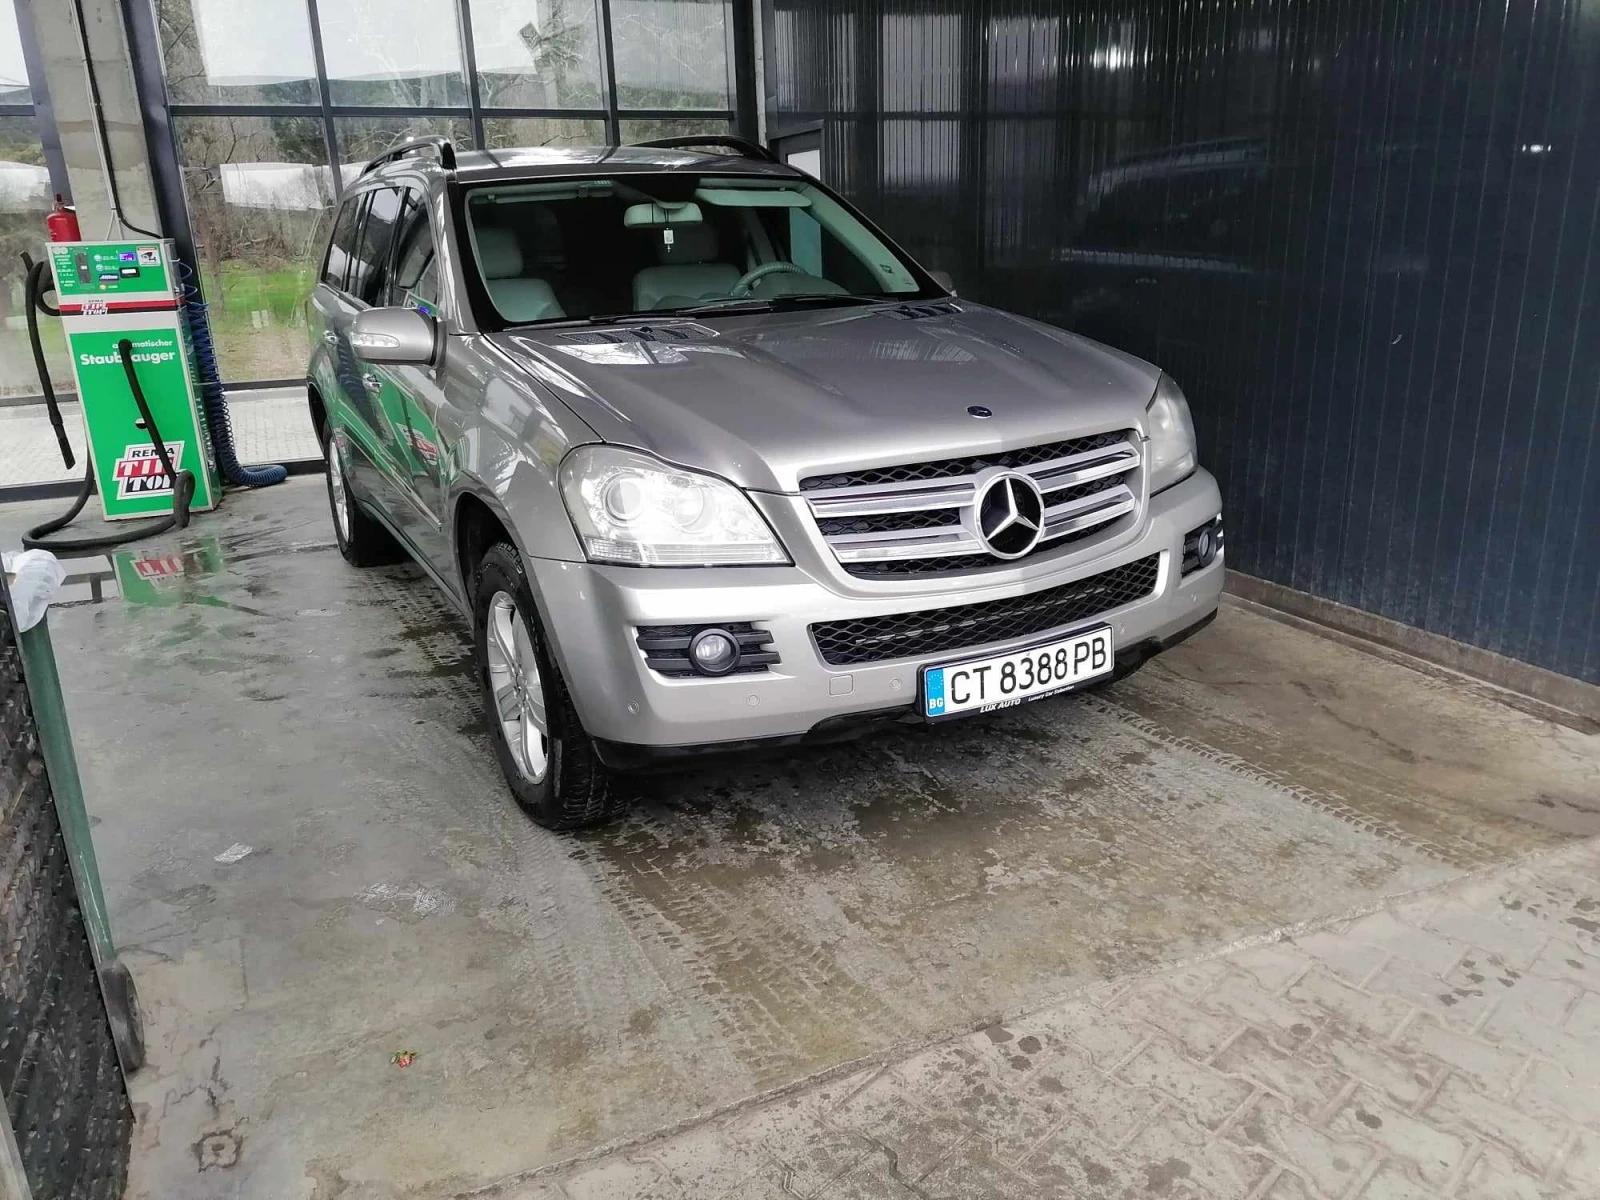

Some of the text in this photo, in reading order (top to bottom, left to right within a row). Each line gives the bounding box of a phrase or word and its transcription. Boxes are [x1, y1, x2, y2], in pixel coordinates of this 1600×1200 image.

[112, 339, 173, 349] amatischer
[80, 351, 175, 366] Staubauger
[950, 637, 1107, 704] CT 8388 PB
[929, 698, 944, 709] BG
[980, 698, 1021, 713] LUX AUTO
